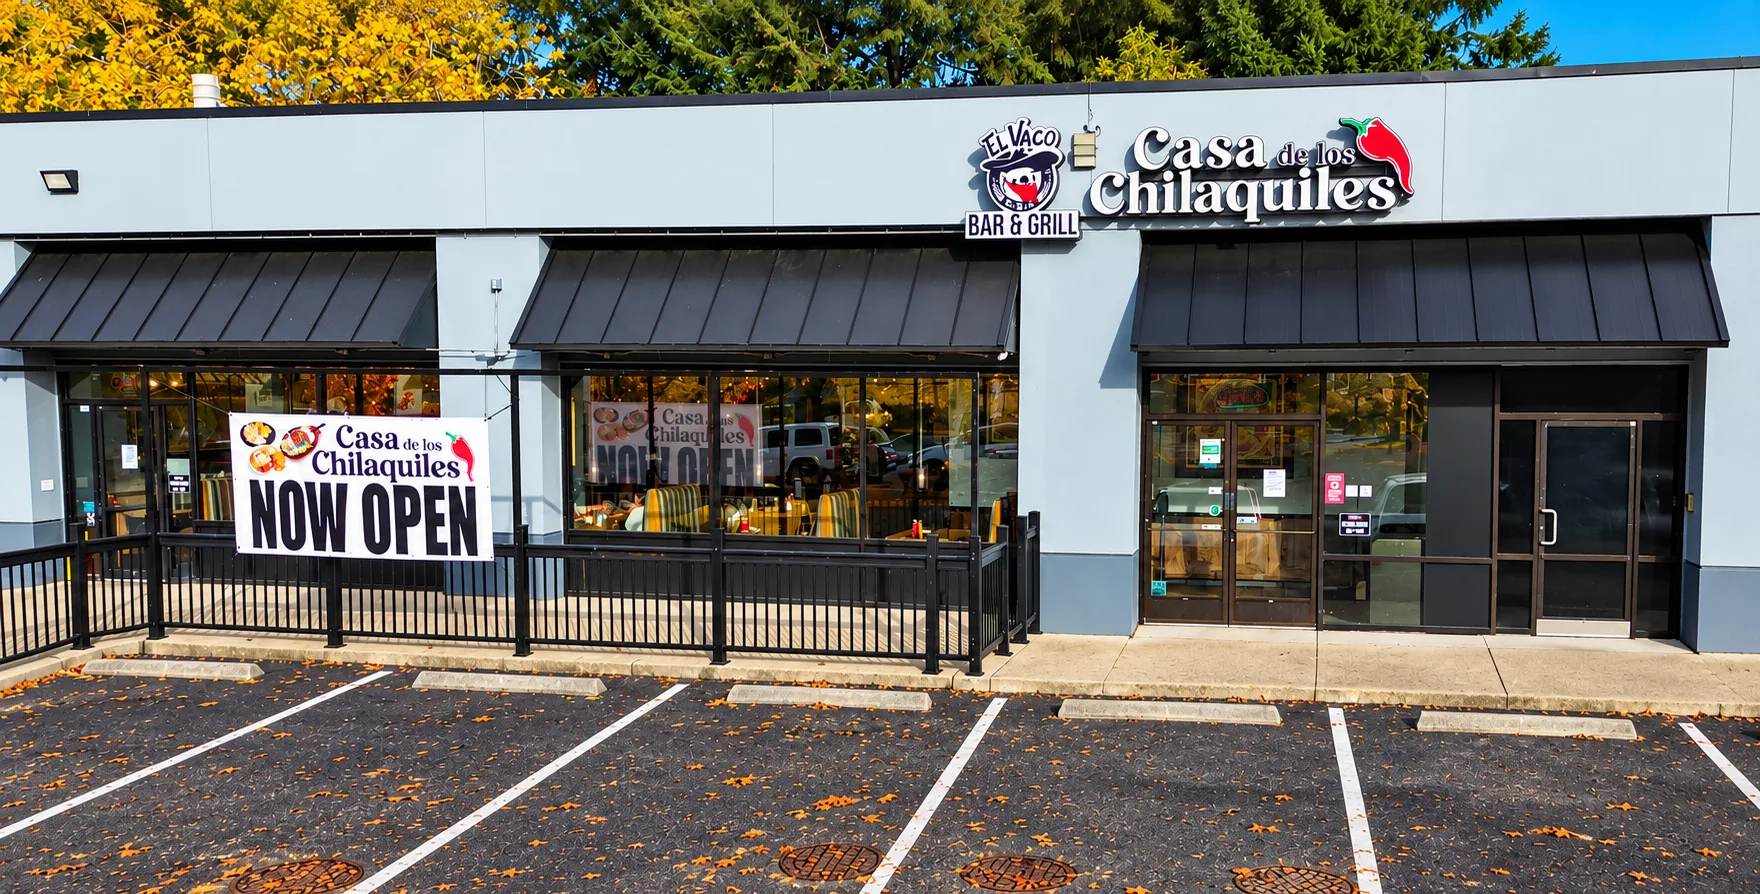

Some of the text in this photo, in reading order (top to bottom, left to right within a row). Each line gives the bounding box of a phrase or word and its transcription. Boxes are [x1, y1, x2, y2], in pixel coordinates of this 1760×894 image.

[981, 120, 1056, 158] EL VACO
[1133, 126, 1356, 171] Casa de los
[1089, 165, 1397, 223] Chilaquiles
[968, 213, 1078, 236] BAR & GRILL
[662, 408, 704, 425] Casa
[335, 424, 443, 451] Casa de los
[645, 425, 745, 447] Chilaqules
[312, 450, 461, 483] Chilaquiles
[249, 479, 479, 557] NOW OPEN
